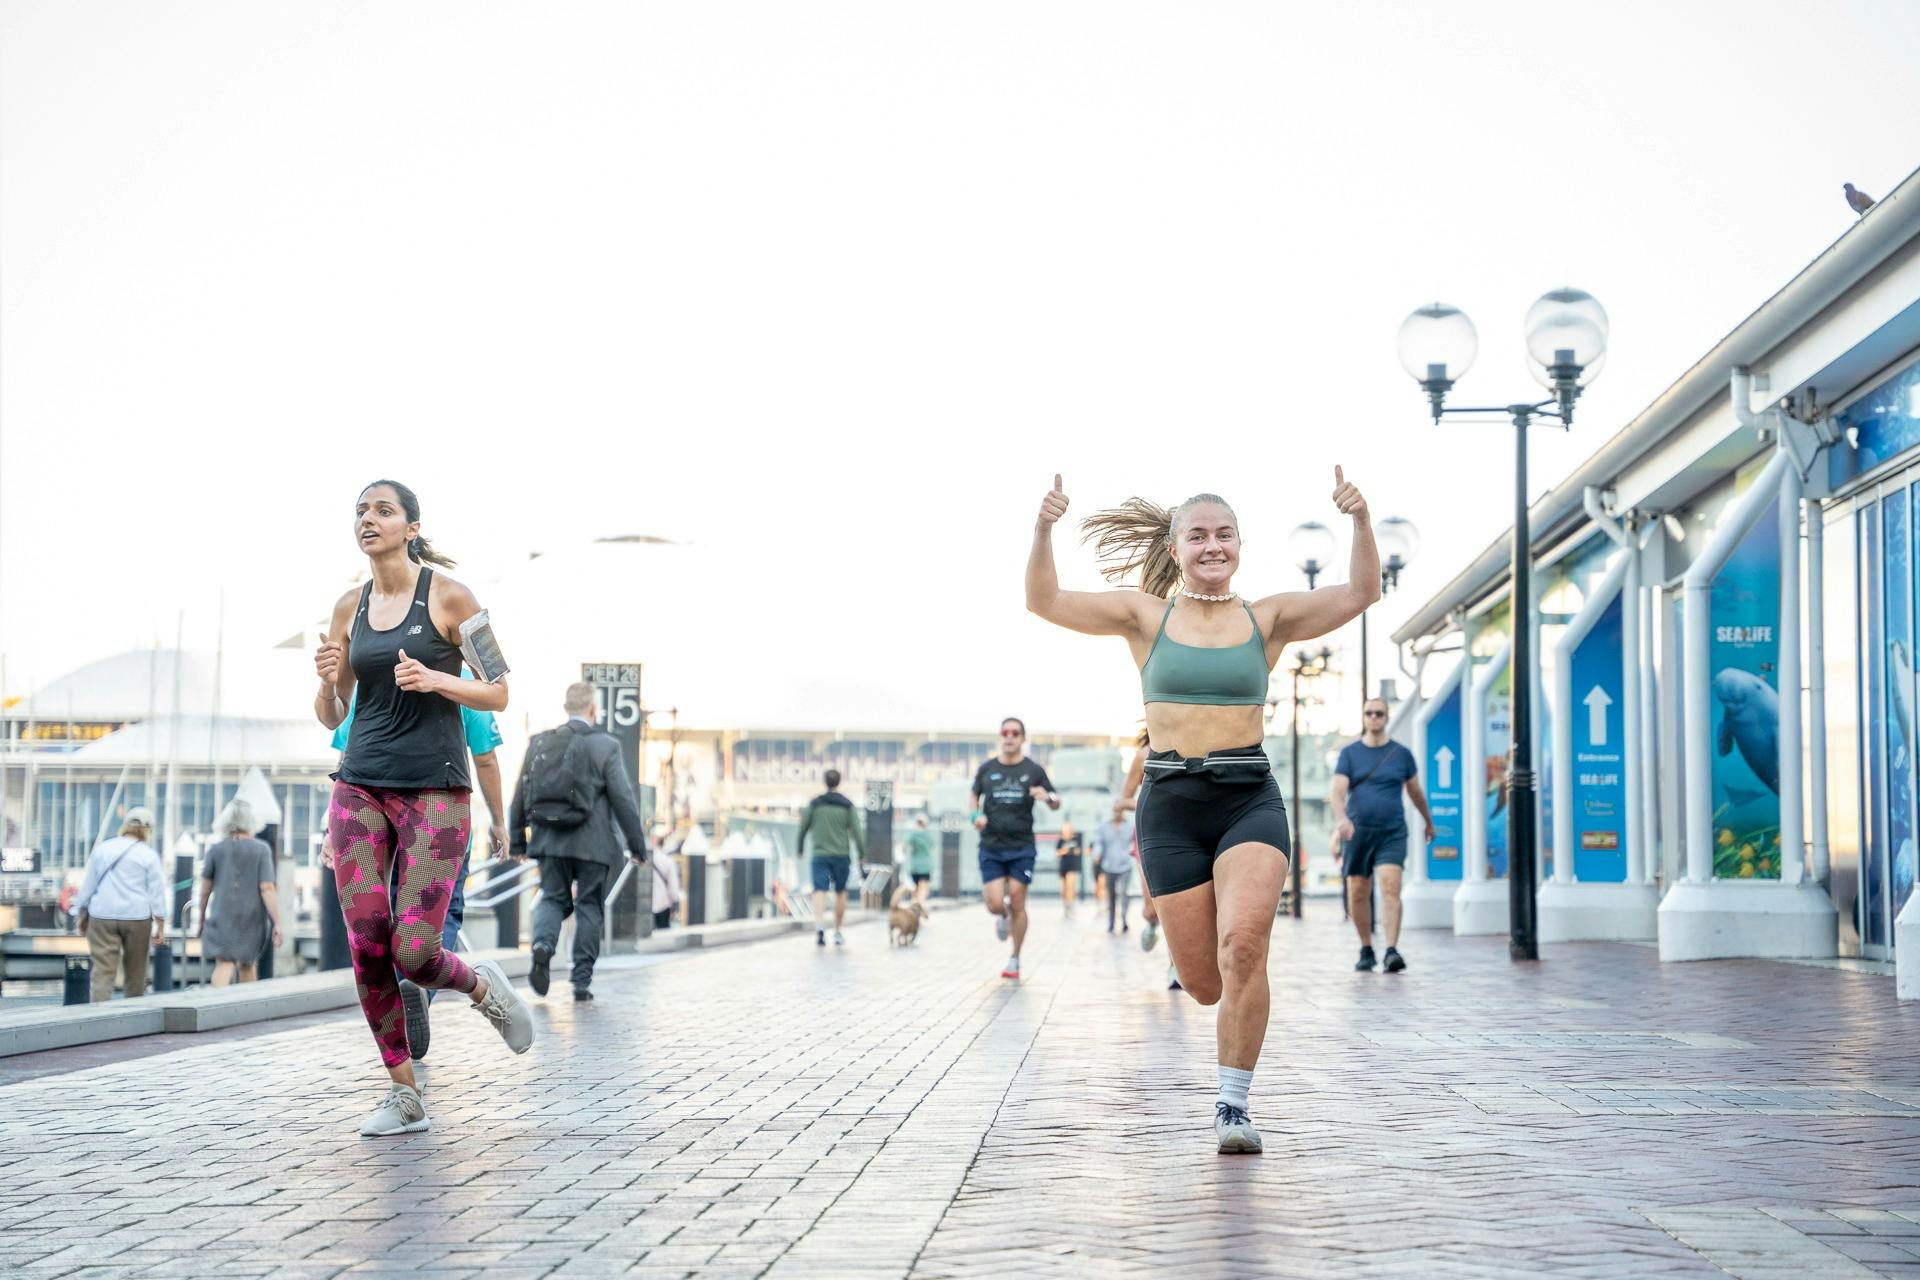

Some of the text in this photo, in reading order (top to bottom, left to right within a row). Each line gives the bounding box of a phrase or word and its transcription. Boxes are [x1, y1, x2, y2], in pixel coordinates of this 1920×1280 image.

[1716, 626, 1742, 642] SEA
[584, 664, 639, 682] PIER 26
